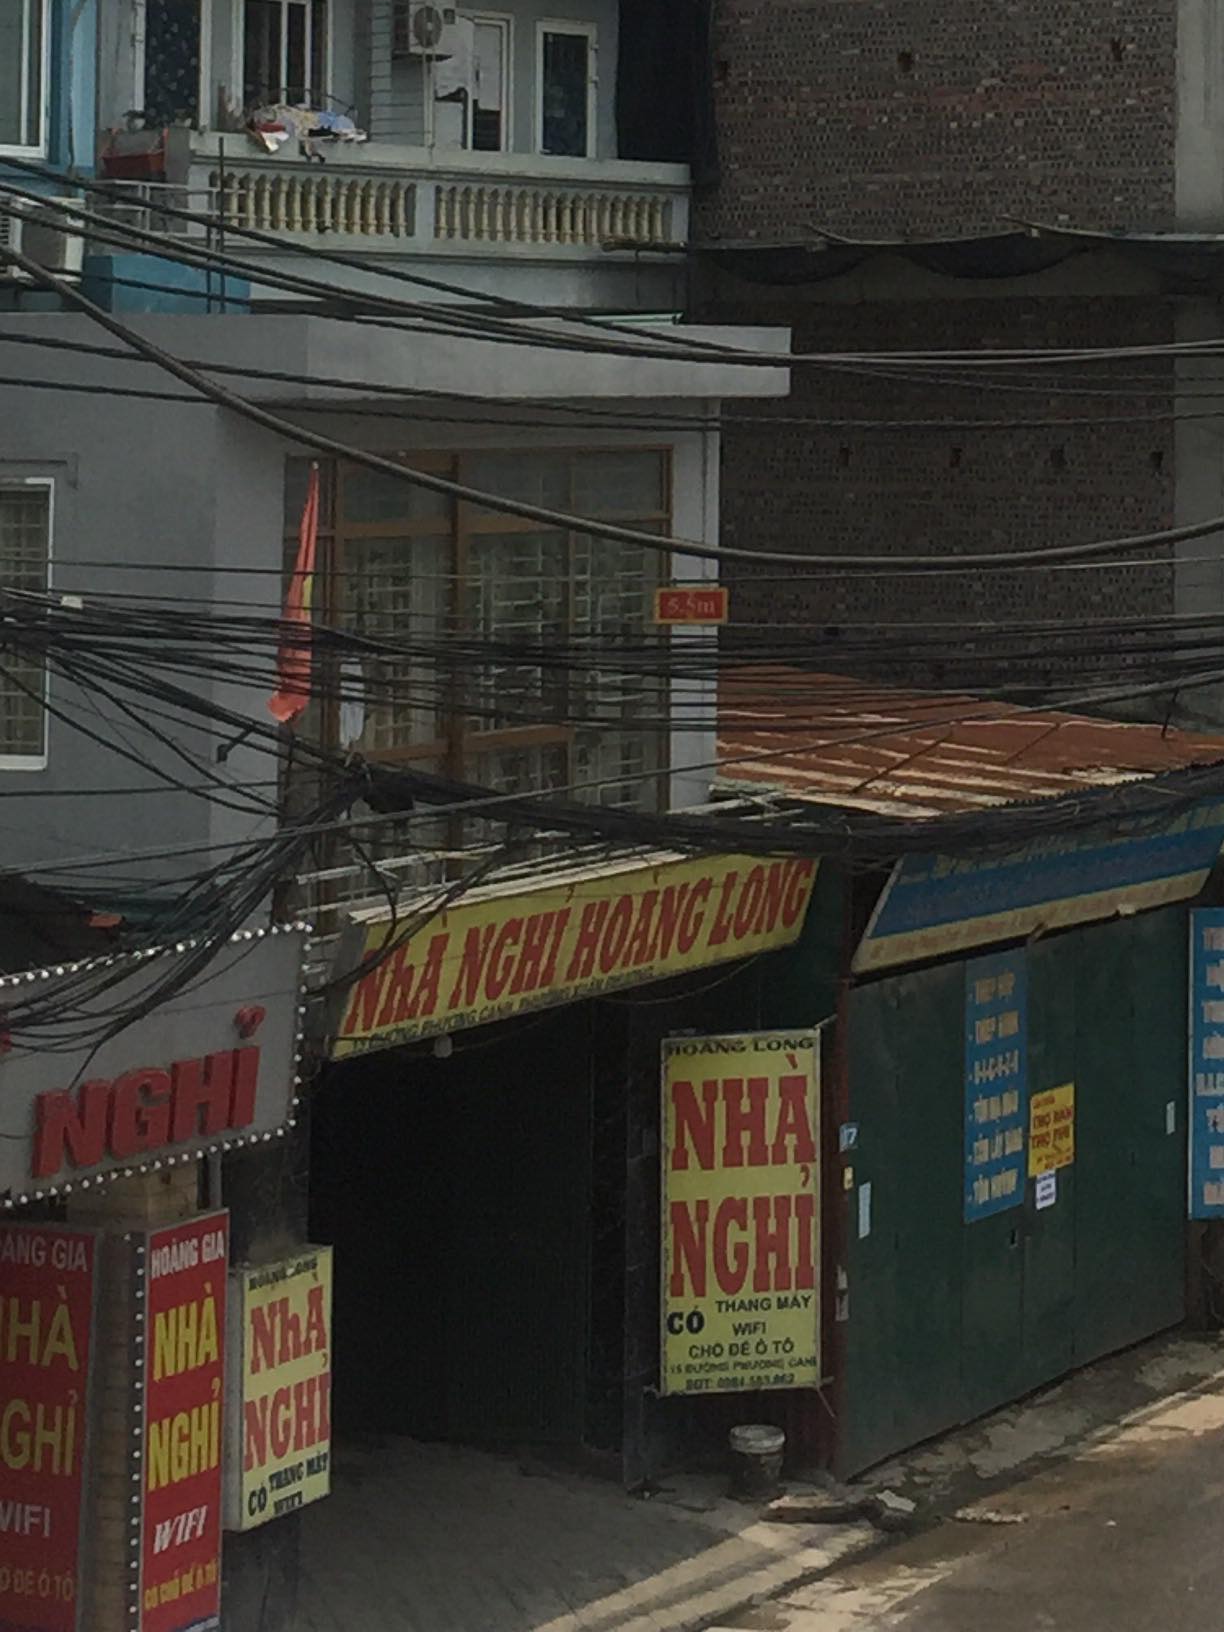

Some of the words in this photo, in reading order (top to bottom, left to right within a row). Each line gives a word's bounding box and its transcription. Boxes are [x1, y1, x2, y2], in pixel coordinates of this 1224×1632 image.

[448, 884, 574, 1010] NGHỈ
[564, 870, 713, 982] HOÀNG
[707, 858, 814, 946] LONG
[753, 1037, 815, 1052] LONG
[32, 1005, 266, 1179] NGHỈ
[672, 1053, 817, 1170] NHÀ
[51, 1238, 88, 1273] GIA
[201, 1229, 225, 1265] GIA
[670, 1165, 815, 1299] NGHỈ
[0, 1285, 80, 1371] HÀ
[153, 1282, 219, 1382] NHÀ
[667, 1306, 705, 1335] CÓ
[715, 1298, 772, 1314] THANG
[776, 1294, 812, 1310] MÁY
[732, 1321, 767, 1337] WIFI
[0, 1389, 78, 1476] GHỈ
[147, 1377, 221, 1492] NGHỈ
[244, 1352, 331, 1472] NGHỈ
[153, 1504, 208, 1555] WIFI
[248, 1482, 267, 1516] CÓ
